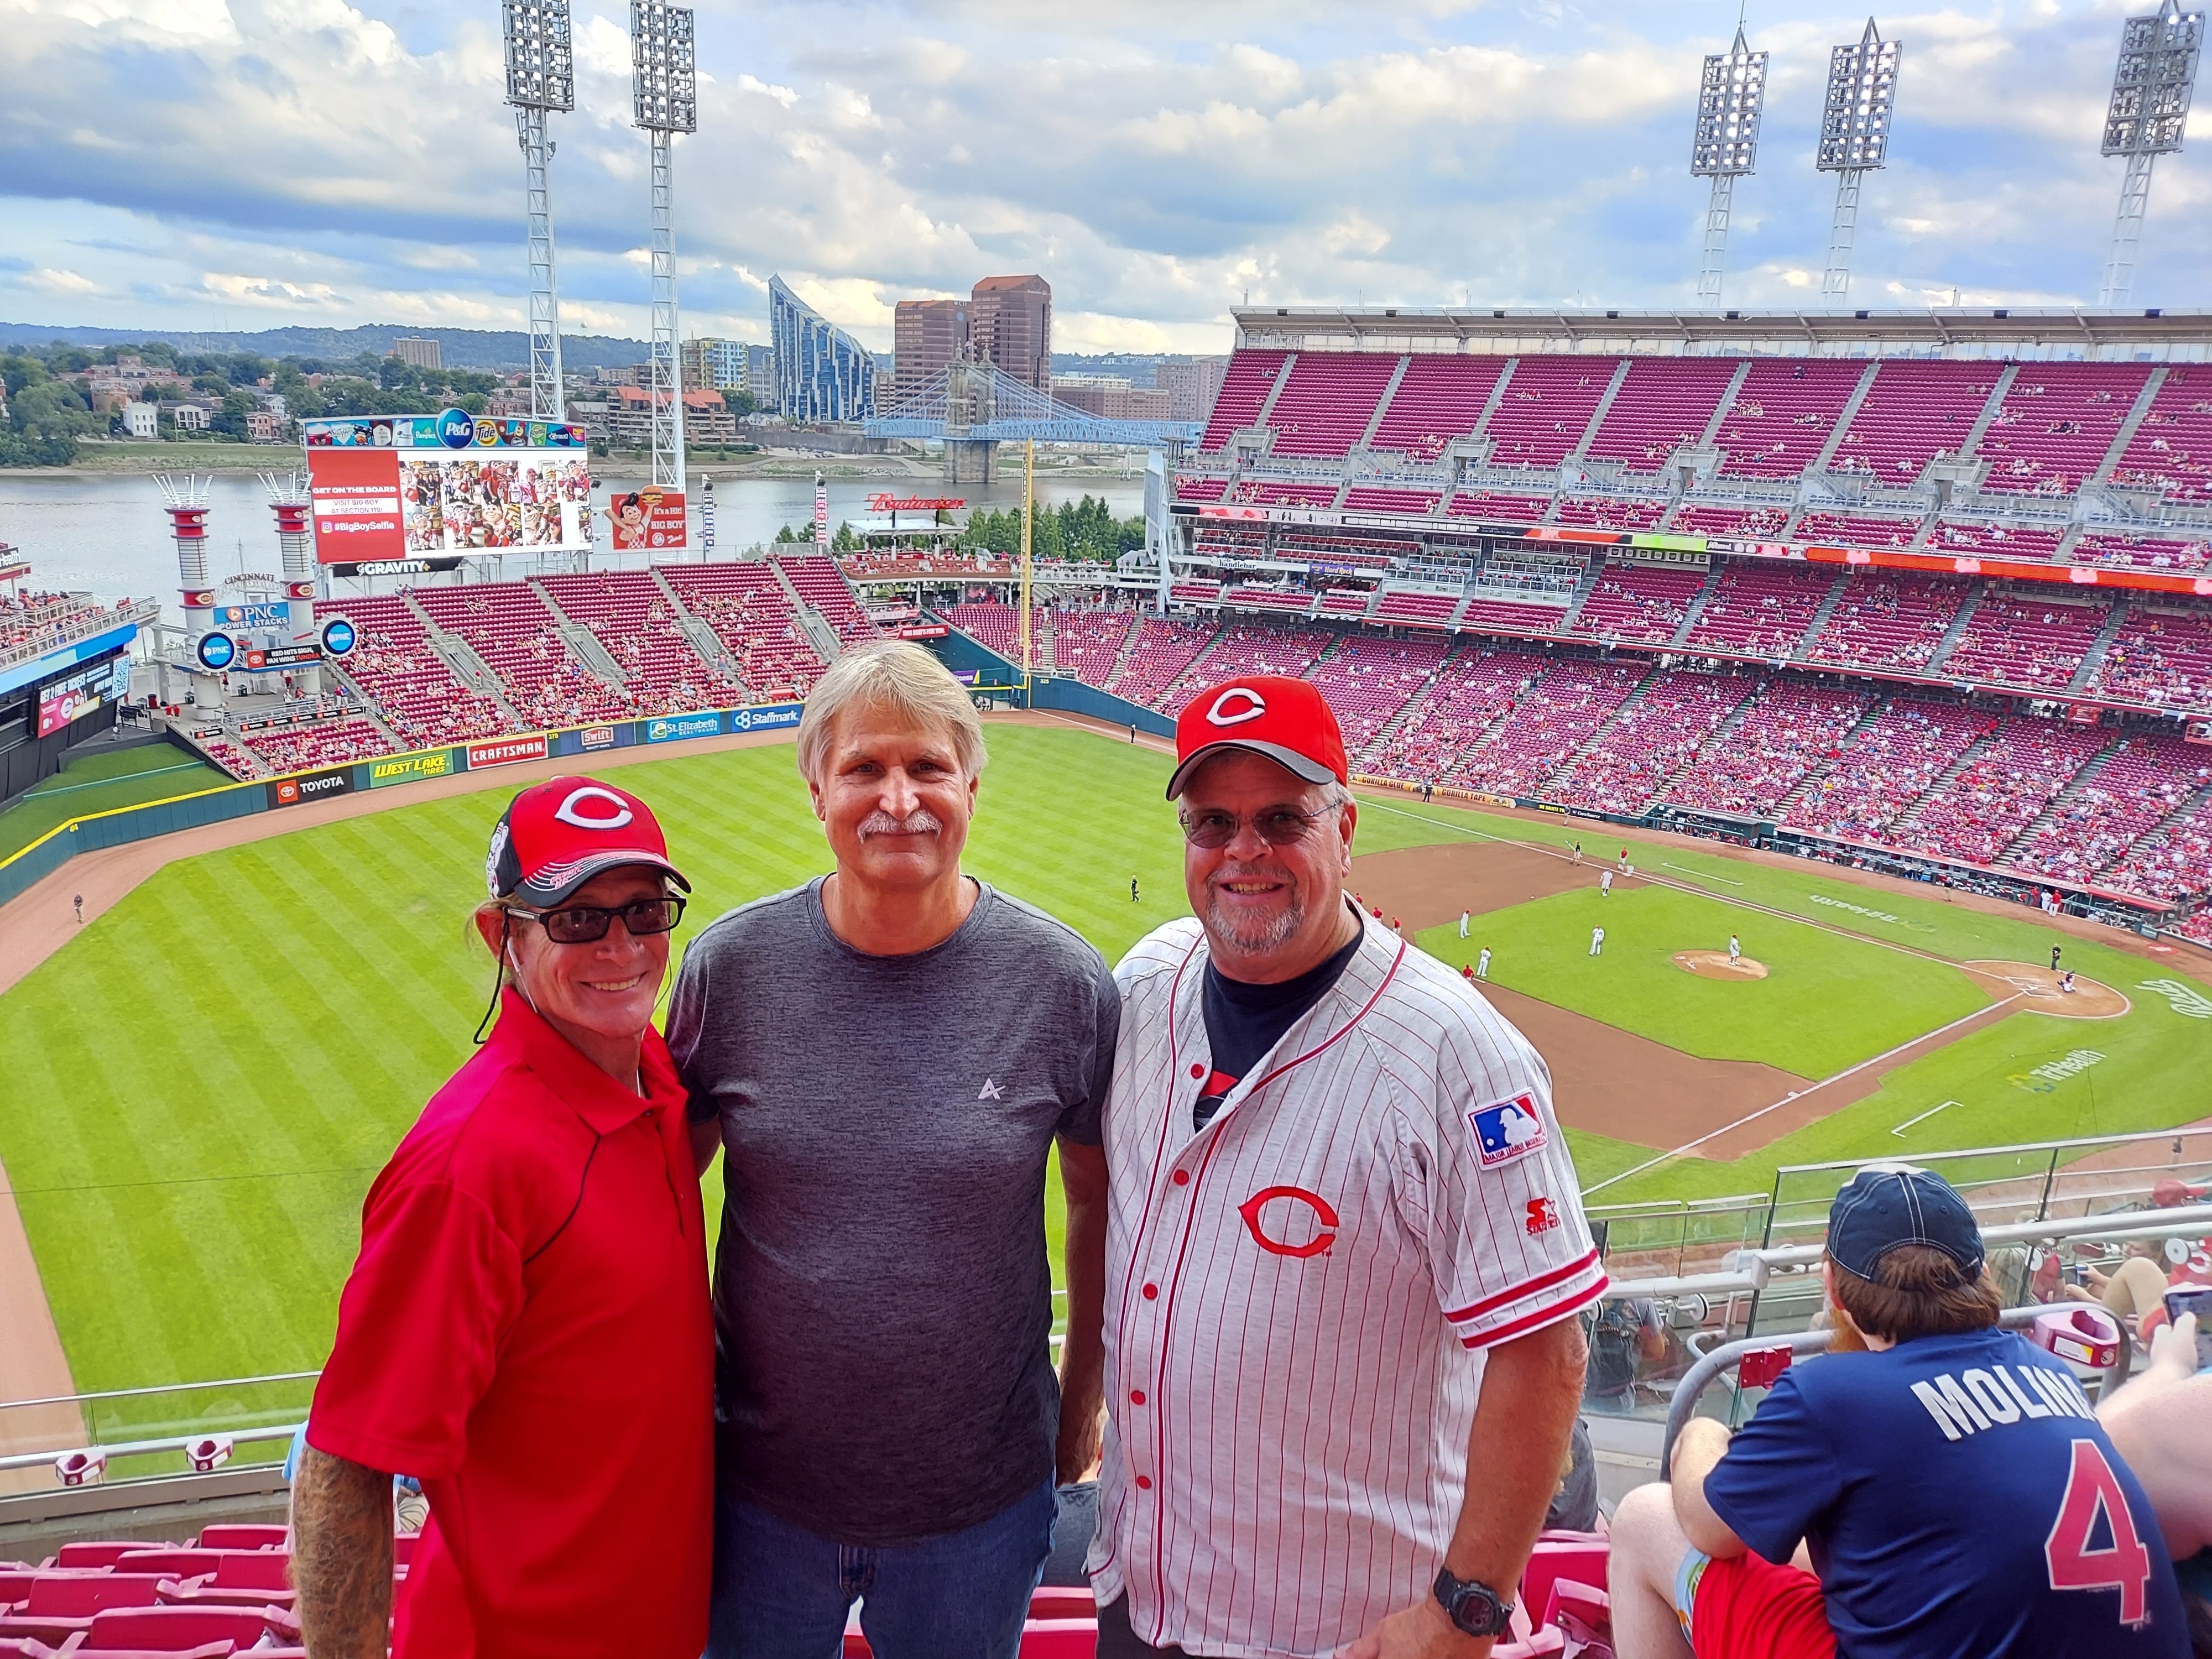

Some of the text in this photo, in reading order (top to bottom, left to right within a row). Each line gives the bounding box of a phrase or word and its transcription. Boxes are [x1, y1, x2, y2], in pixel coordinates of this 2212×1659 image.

[330, 427, 353, 437] Swiffer
[415, 430, 437, 439] Pampers
[445, 422, 471, 436] P&G
[476, 426, 495, 441] Tide
[530, 427, 546, 437] Bounty
[868, 492, 966, 512] Budweiser
[334, 521, 394, 533] #BigBoySelfie
[651, 520, 684, 529] BIG BOY
[364, 561, 425, 575] GRAVITY
[1219, 560, 1256, 568] handlebar
[1339, 567, 1353, 575] Rock
[224, 573, 275, 585] CINCINNATI
[243, 605, 279, 620] PNC
[219, 617, 288, 630] POWER STACKS
[333, 632, 351, 641] PNC
[212, 645, 230, 655] PNC
[1206, 687, 1266, 727] C
[752, 709, 799, 726] Staffmark
[667, 718, 718, 733] St. Elizabeth
[584, 730, 612, 742] Swift
[471, 741, 542, 762] CRAFTSMAN
[374, 754, 447, 778] WEST LAKE
[422, 766, 445, 775] TIRES
[299, 775, 344, 794] TOYOTA
[1361, 776, 1405, 790] GORILLA GLUE
[1442, 789, 1486, 802] GORILLA TAPE
[554, 786, 633, 830] C
[1577, 810, 1601, 819] CareSource
[2029, 1050, 2107, 1081] TriHealth
[1484, 1134, 1547, 1162] MAJOR LEAGUE BASEBALL
[1238, 1186, 1339, 1258] C
[1526, 1218, 1561, 1235] STARTER
[2044, 1439, 2151, 1625] 4
